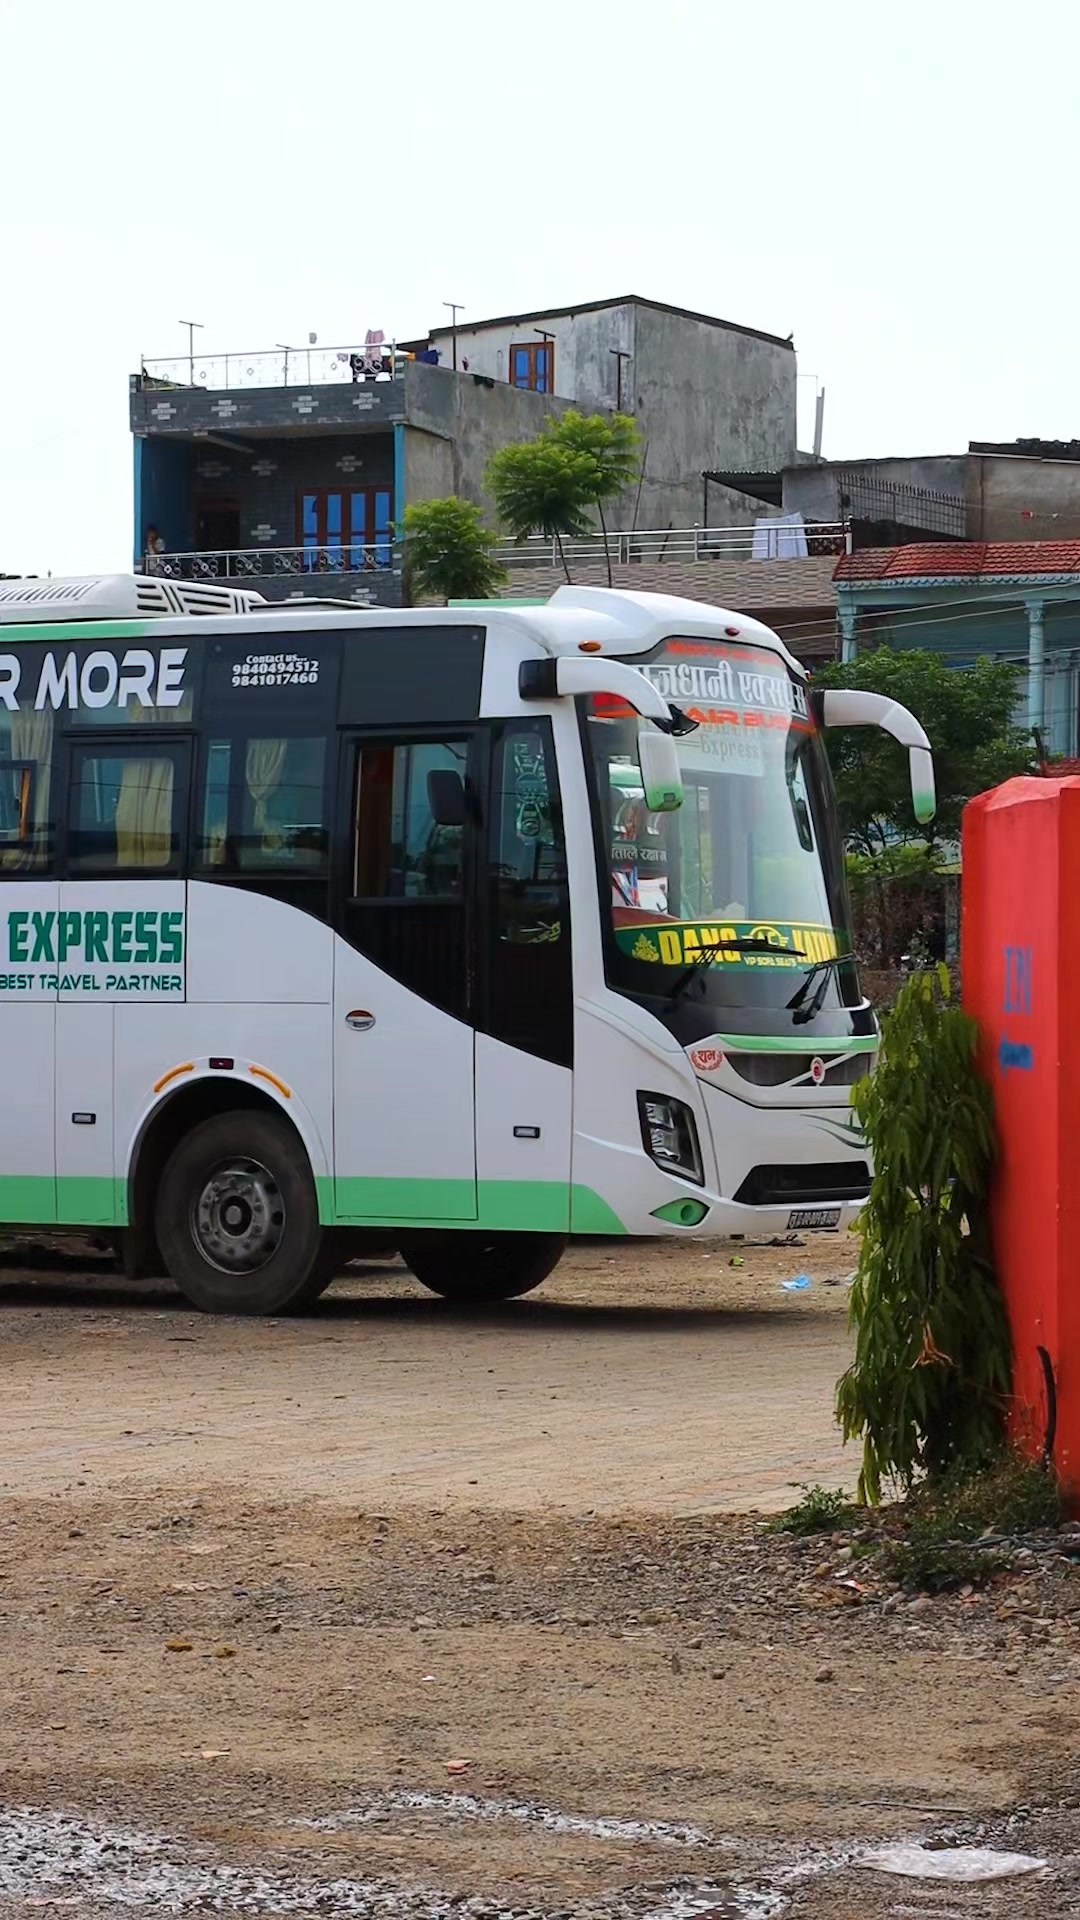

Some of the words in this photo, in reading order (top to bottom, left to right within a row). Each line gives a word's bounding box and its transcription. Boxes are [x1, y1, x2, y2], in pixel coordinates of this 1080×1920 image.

[232, 661, 319, 675] 9840494512
[245, 654, 284, 664] Contact
[34, 648, 188, 711] MORE
[231, 672, 319, 687] 9841017460
[687, 707, 739, 726] AIR
[743, 711, 790, 730] BUS
[8, 911, 184, 963] EXPRESS
[657, 928, 741, 966] DANG
[0, 974, 35, 990] BEST
[39, 974, 101, 990] TRAVEL
[106, 974, 182, 991] PARTNER
[1003, 946, 1032, 1016] IN
